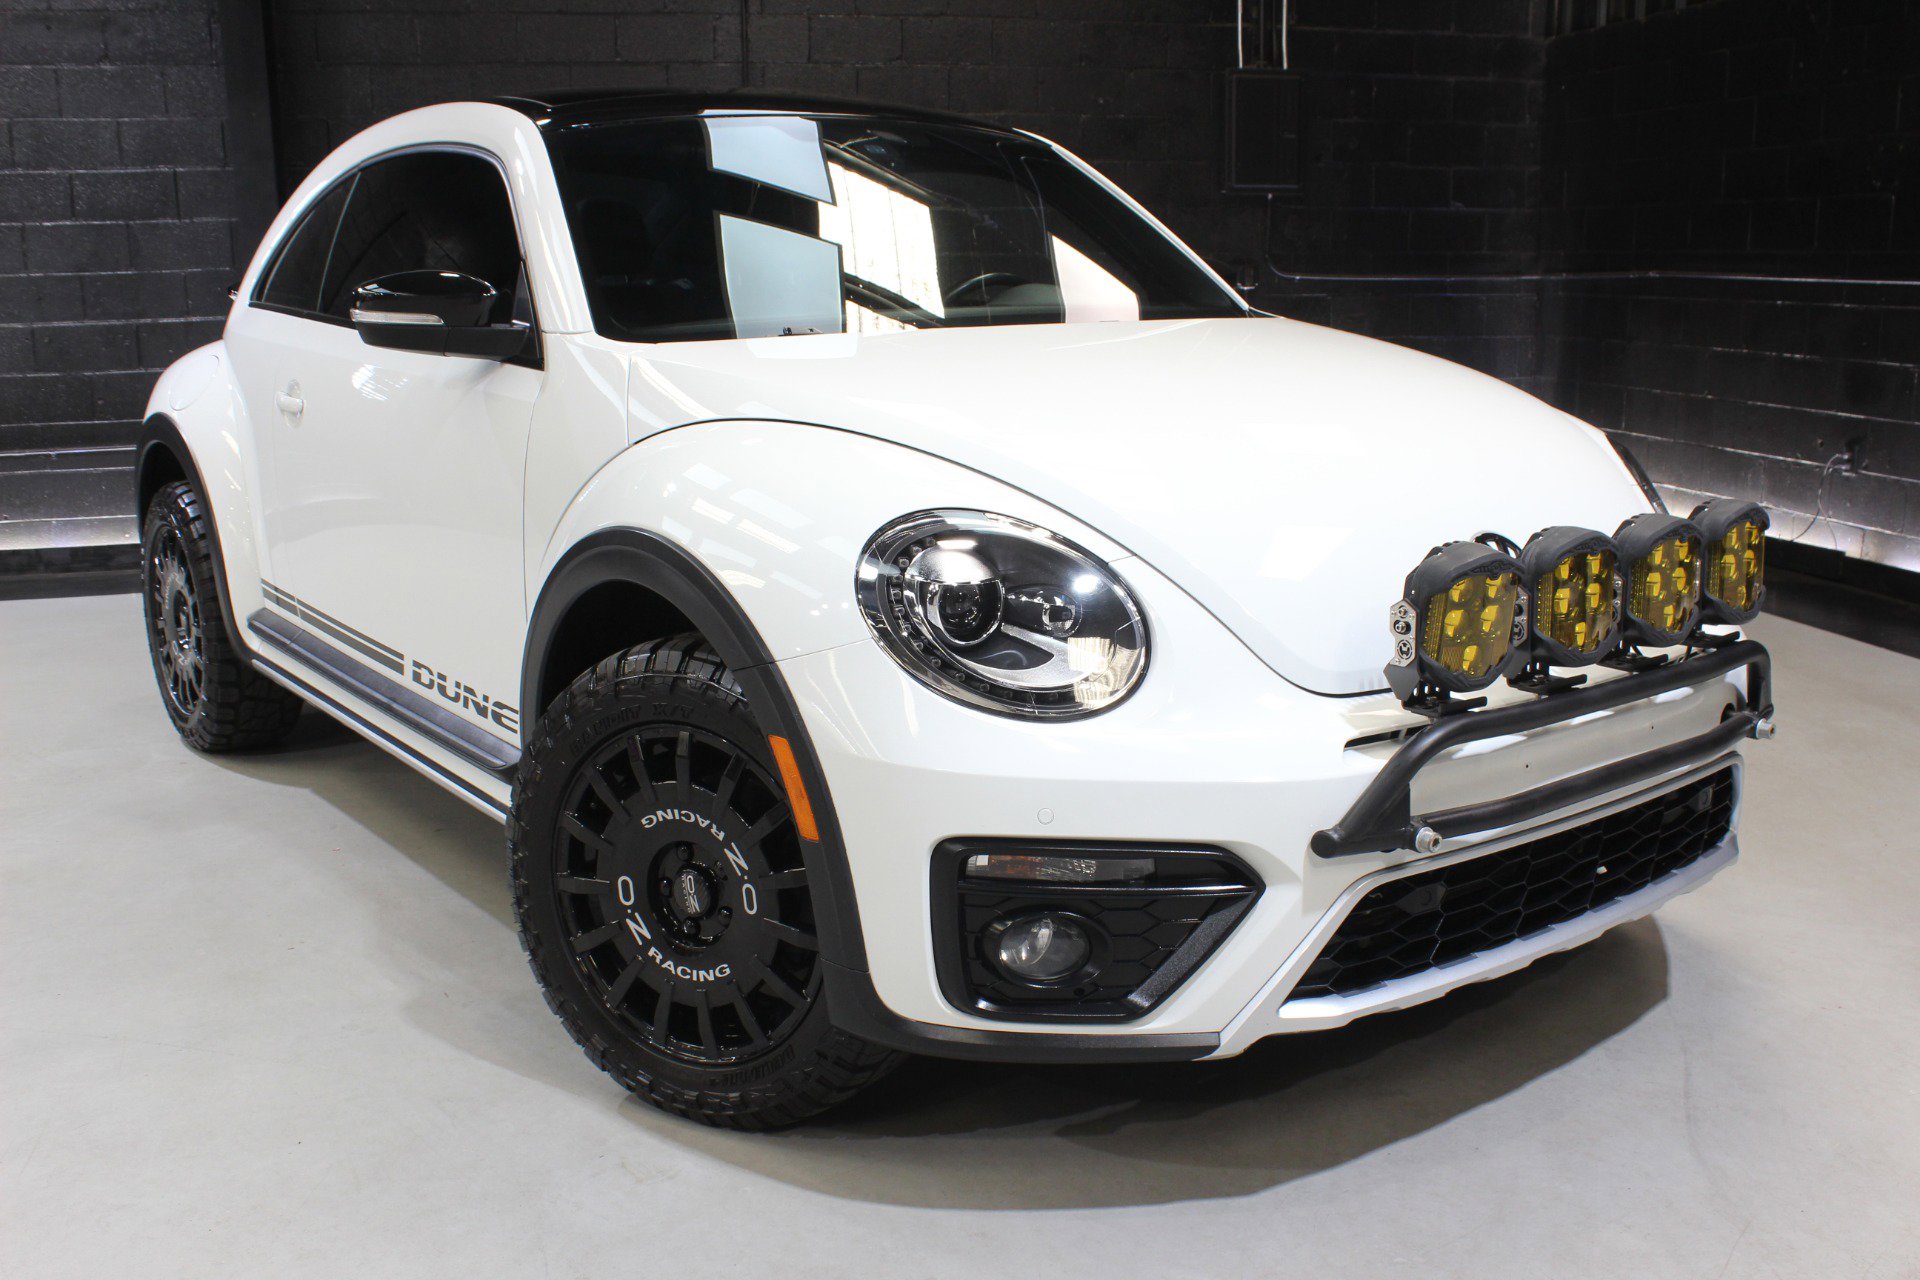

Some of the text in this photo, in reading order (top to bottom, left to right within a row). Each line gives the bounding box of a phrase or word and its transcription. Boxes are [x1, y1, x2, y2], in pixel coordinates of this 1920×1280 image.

[412, 660, 519, 734] DUNE
[640, 808, 725, 841] RACING
[648, 946, 731, 982] RACING
